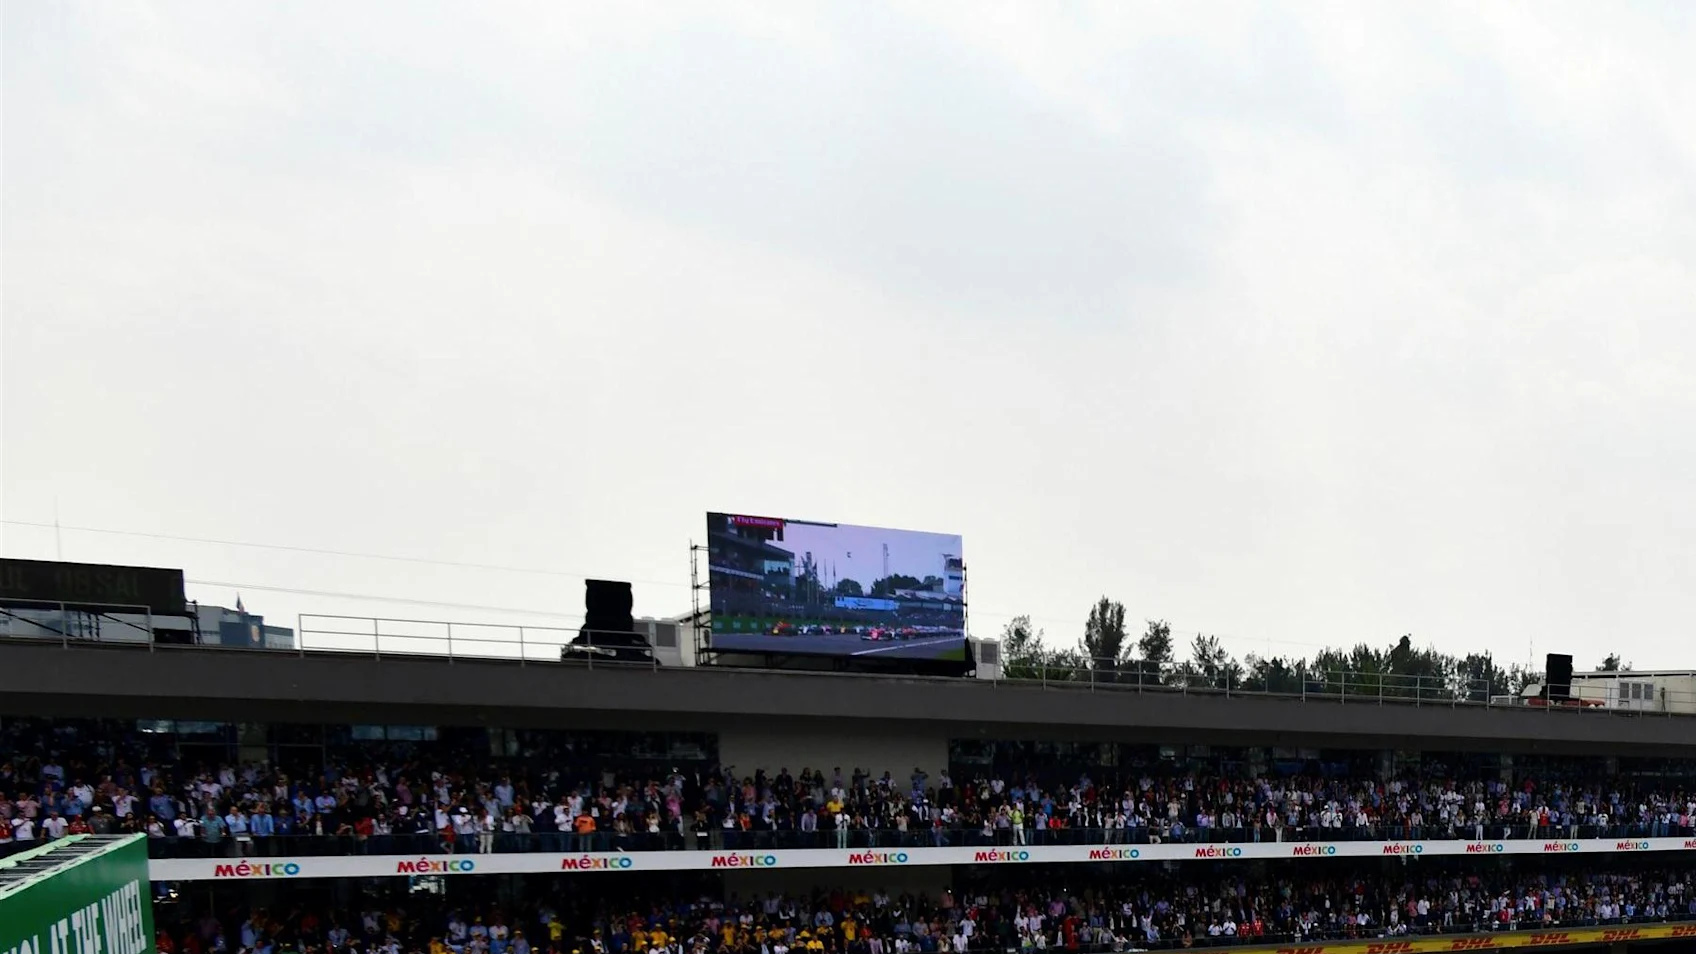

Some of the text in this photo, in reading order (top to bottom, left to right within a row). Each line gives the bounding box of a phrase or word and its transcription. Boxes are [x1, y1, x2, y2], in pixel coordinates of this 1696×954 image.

[1531, 933, 1569, 944] DHL
[1604, 930, 1639, 939] DHL
[1368, 942, 1412, 954] DHL
[1452, 938, 1493, 949] DHL
